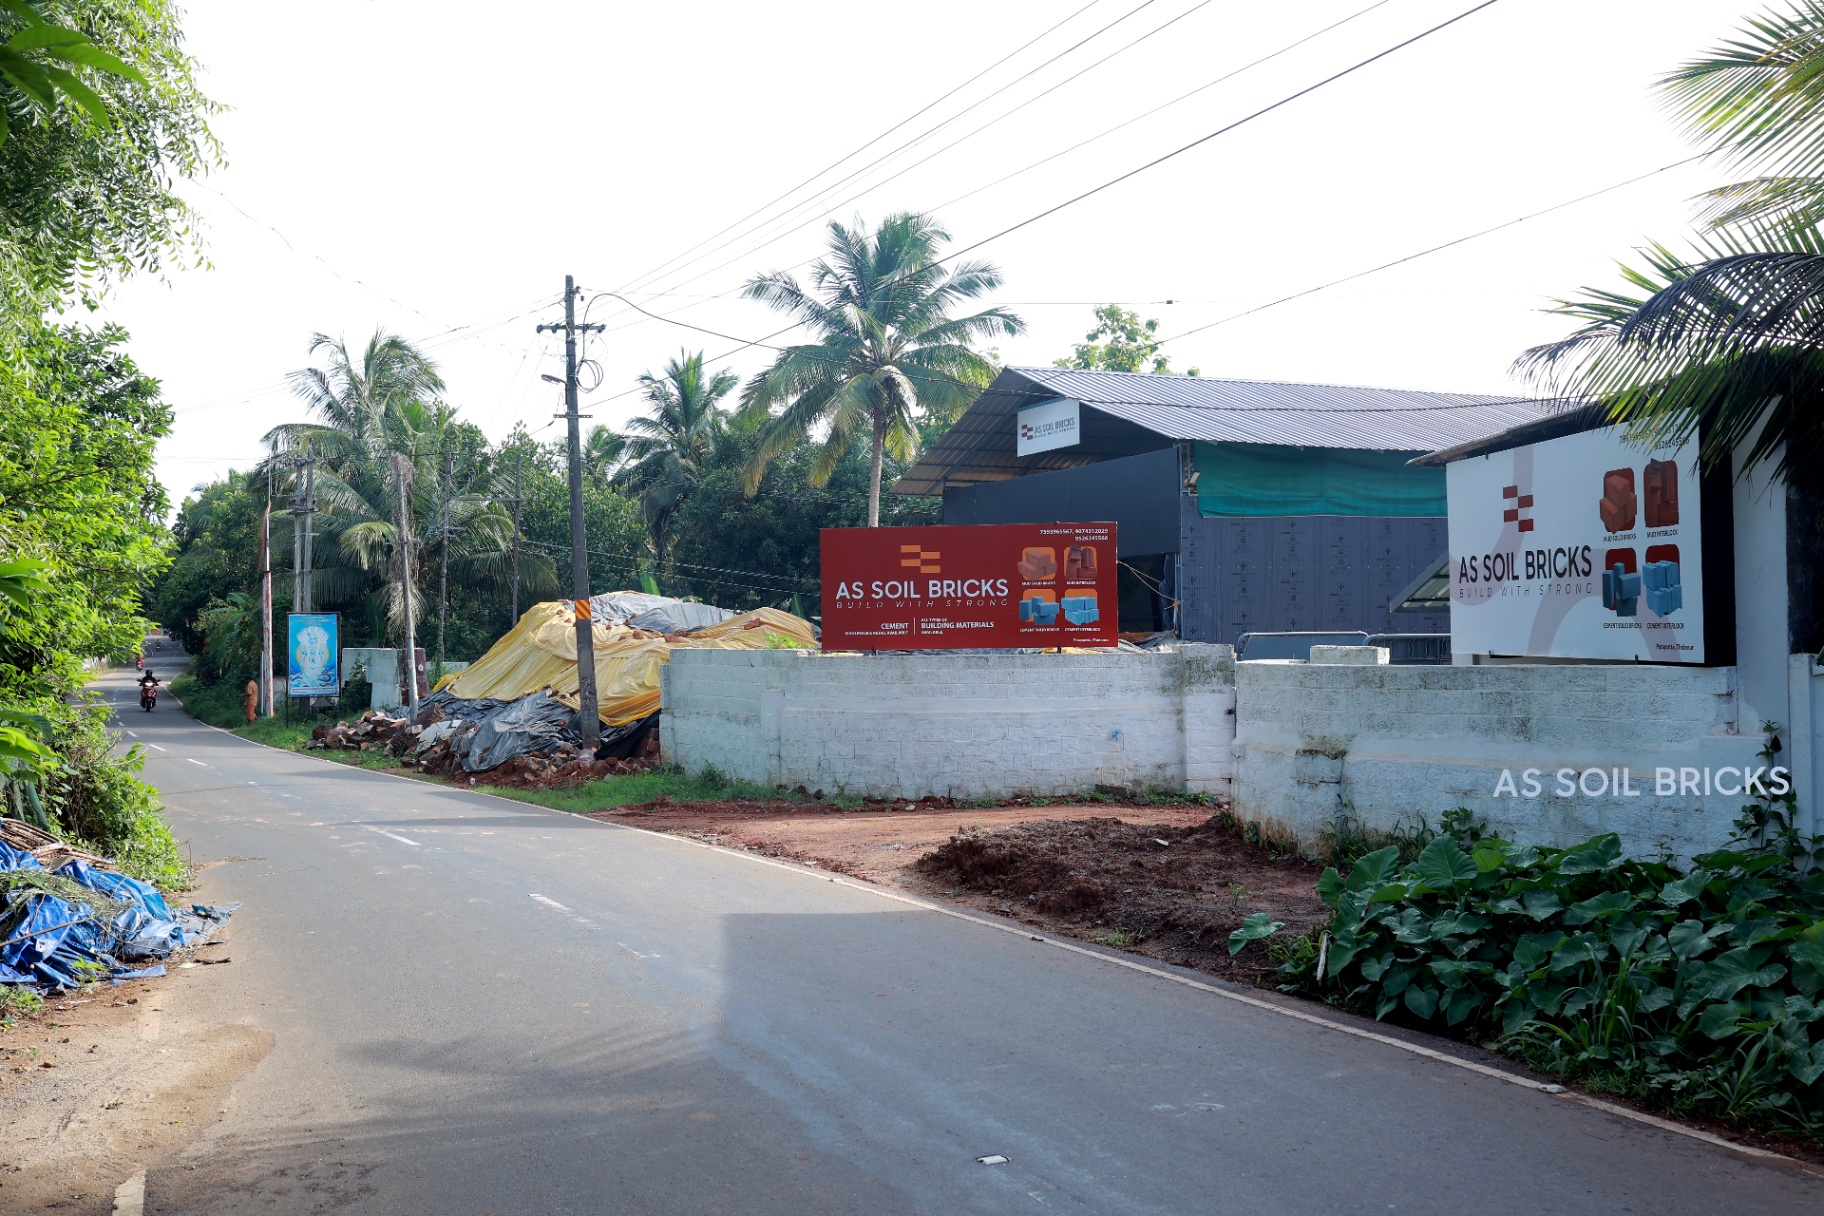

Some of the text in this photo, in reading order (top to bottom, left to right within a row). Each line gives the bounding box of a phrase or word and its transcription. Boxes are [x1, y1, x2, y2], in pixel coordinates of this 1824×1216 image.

[1055, 417, 1075, 430] BRICKS
[1459, 545, 1592, 583] AS SOIL BRICKS
[836, 579, 1009, 599] AS SOIL BRICKS
[1459, 582, 1592, 599] BUILD WITH STRONG
[836, 599, 1008, 609] BUILD WITH STRONG
